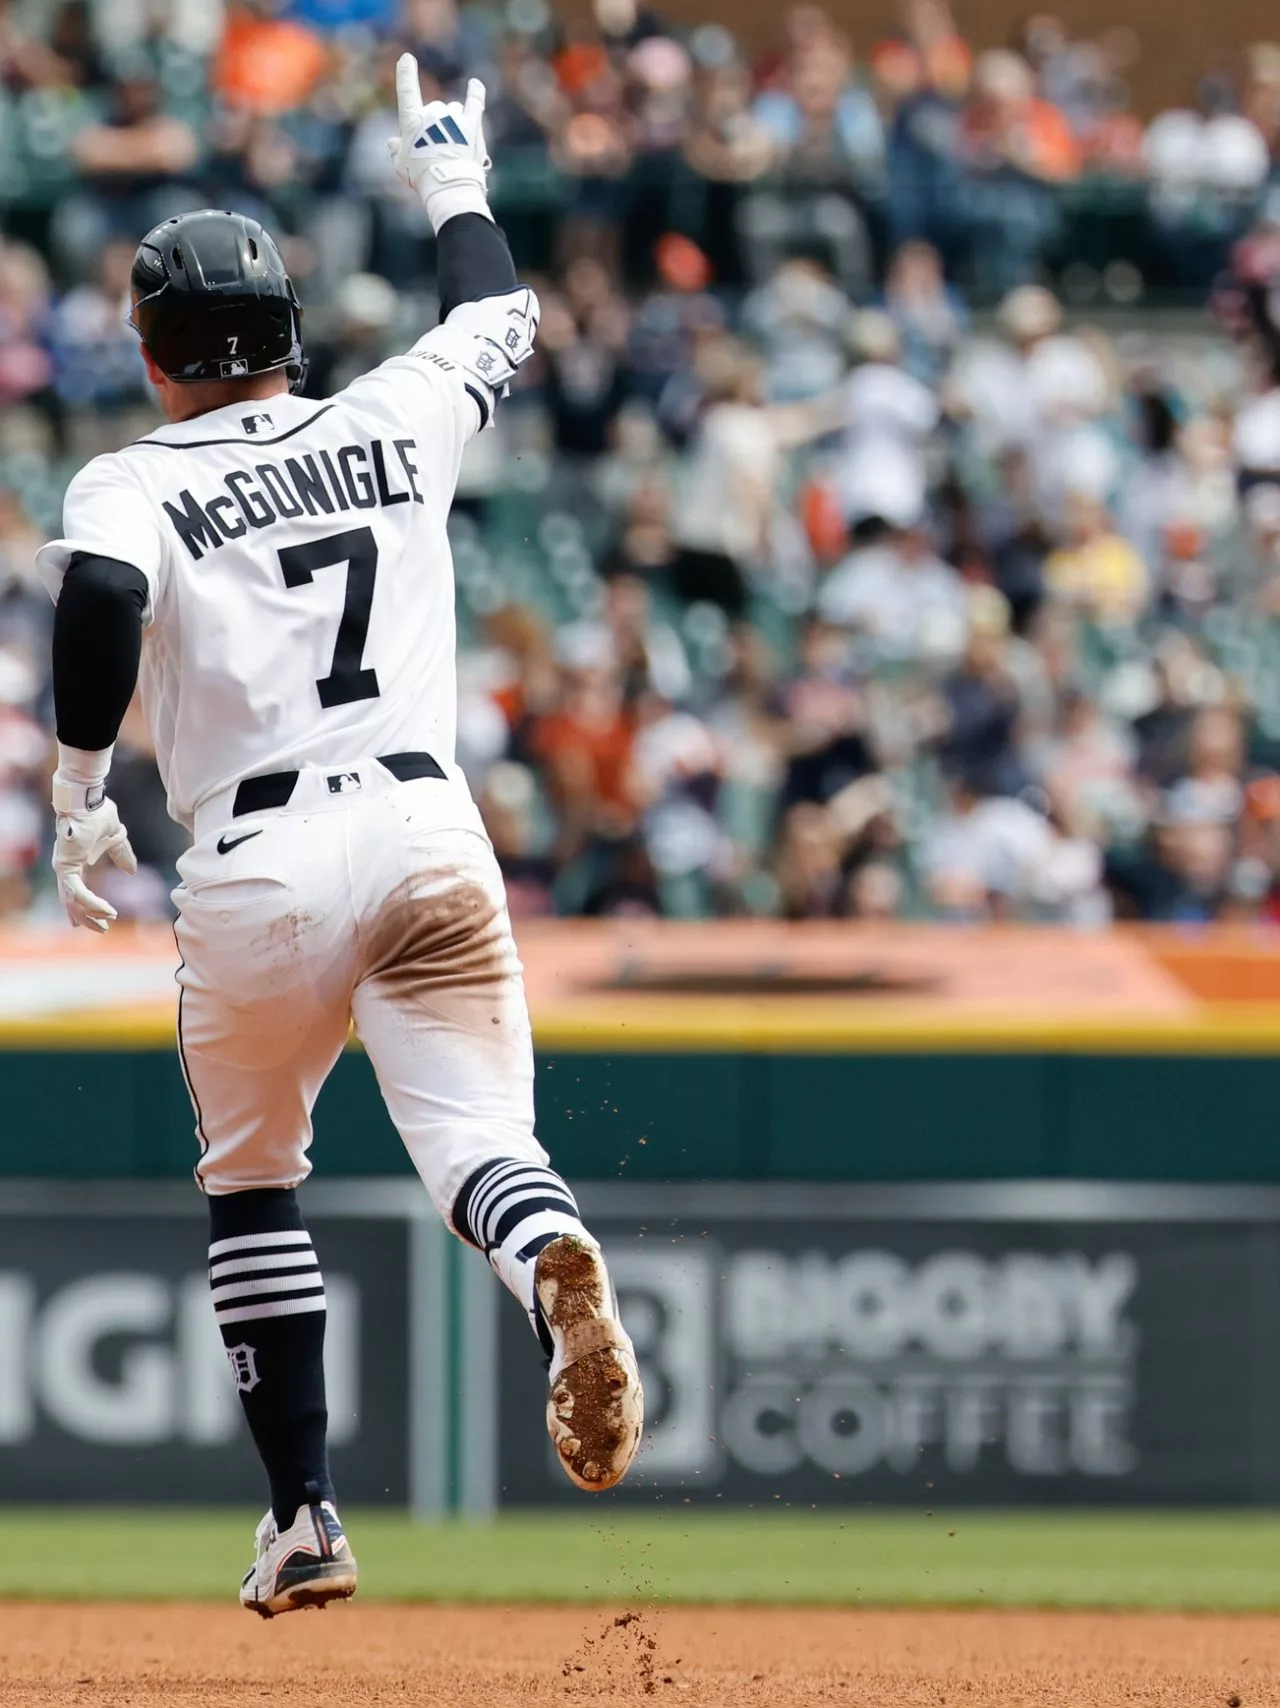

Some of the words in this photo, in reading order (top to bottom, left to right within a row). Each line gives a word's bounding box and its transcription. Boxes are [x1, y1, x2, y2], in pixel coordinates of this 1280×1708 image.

[227, 336, 239, 355] 7
[161, 439, 424, 561] McGONIGLE
[276, 525, 379, 709] 7
[722, 1375, 1138, 1476] COFFEE
